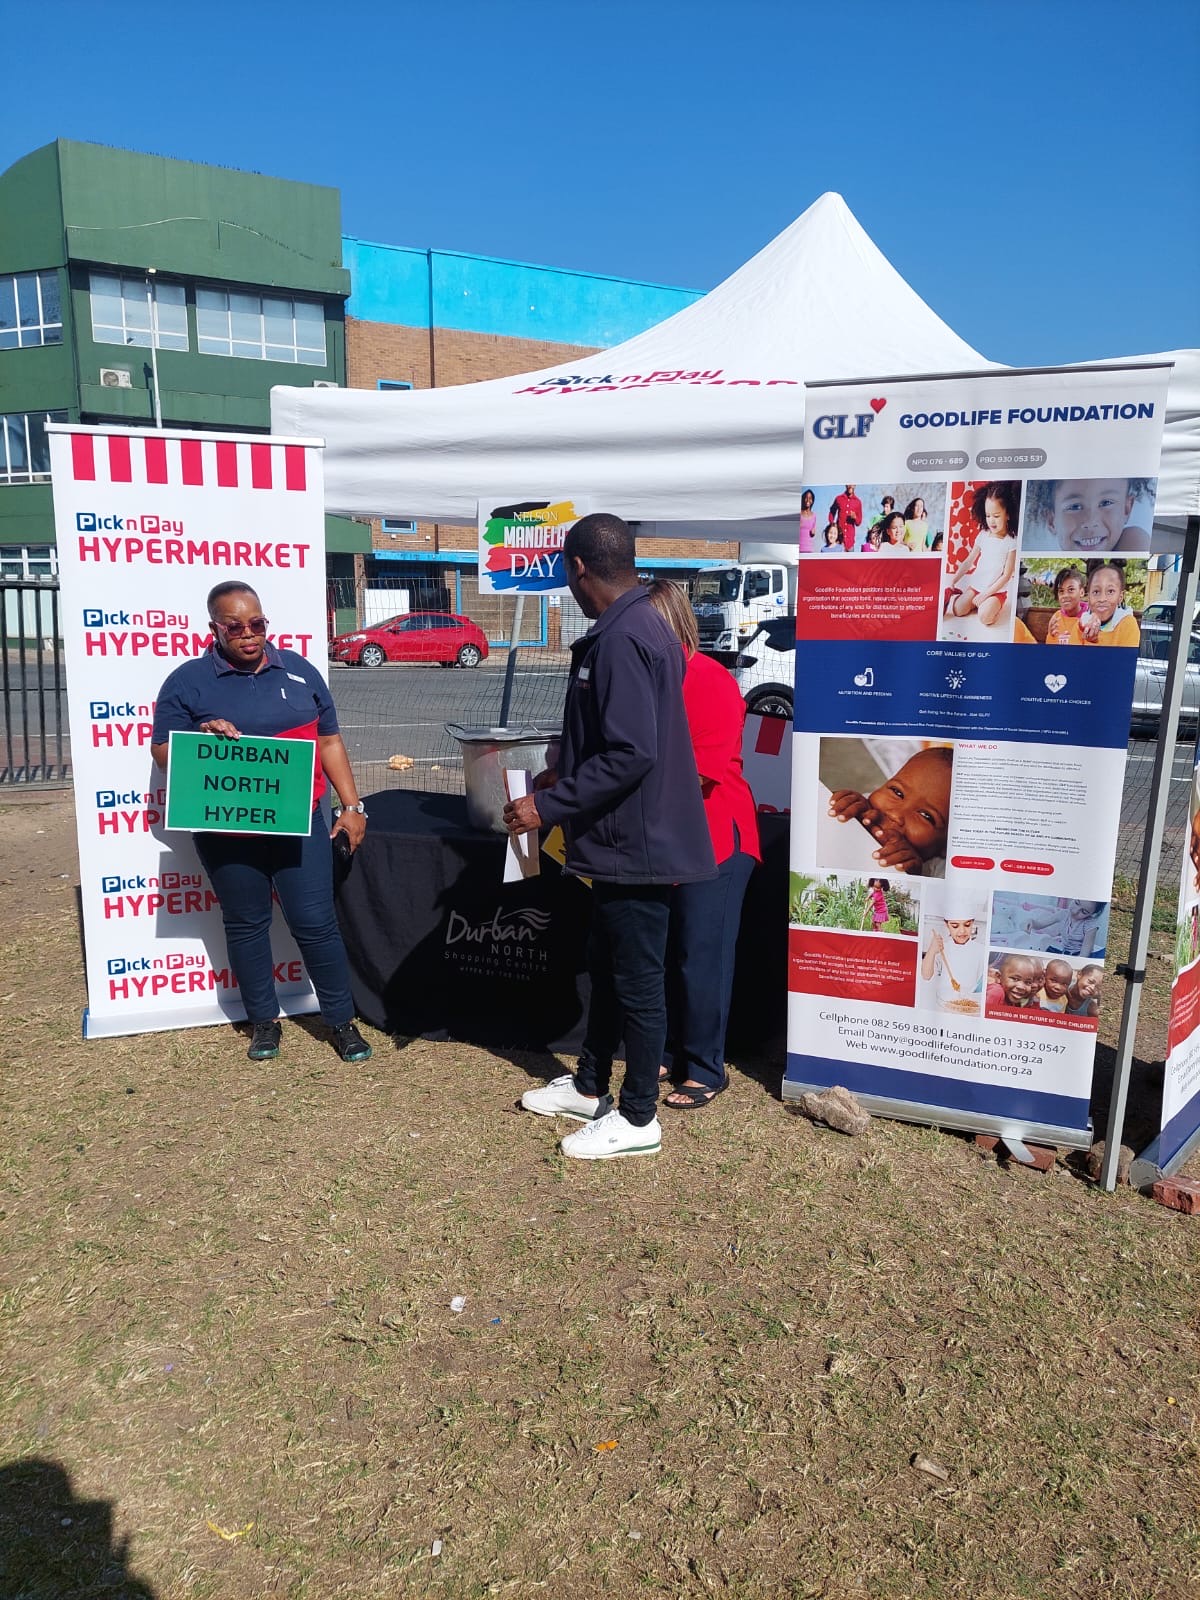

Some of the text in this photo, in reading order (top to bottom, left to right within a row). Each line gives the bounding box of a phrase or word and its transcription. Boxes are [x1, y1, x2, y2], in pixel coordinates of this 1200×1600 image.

[813, 413, 874, 439] GLF
[900, 402, 1154, 428] GOODLIFE FOUNDATION
[76, 513, 183, 536] Pick n Pay
[513, 512, 559, 522] NELSON
[504, 526, 566, 548] MANDELA
[78, 537, 310, 568] HYPERMARKET
[509, 553, 559, 578] DAY
[83, 609, 189, 629] Pick n Pay
[90, 701, 136, 719] Pick
[138, 705, 149, 716] n
[197, 743, 289, 765] DURBAN
[203, 775, 280, 795] NORTH
[96, 790, 141, 808] Pick
[144, 793, 154, 804] n
[205, 805, 276, 824] HYPER
[102, 873, 202, 893] Pick n Pay
[446, 906, 536, 944] Durban
[444, 951, 549, 972] Shopping Centre
[491, 944, 547, 961] NORTH
[107, 954, 205, 975] Pick n Pay
[819, 1011, 869, 1025] Cellphone
[871, 1018, 890, 1029] 082
[892, 1021, 911, 1031] 569
[913, 1023, 938, 1036] 8300
[946, 1029, 991, 1043] Landline
[994, 1036, 1012, 1047] 031
[1016, 1039, 1036, 1050] 332
[1038, 1043, 1066, 1054] 0547
[838, 1026, 1043, 1064] Email Danny@goodlifefoundation.org.za
[846, 1039, 1032, 1075] Web www.goodlifefoundation.org.za
